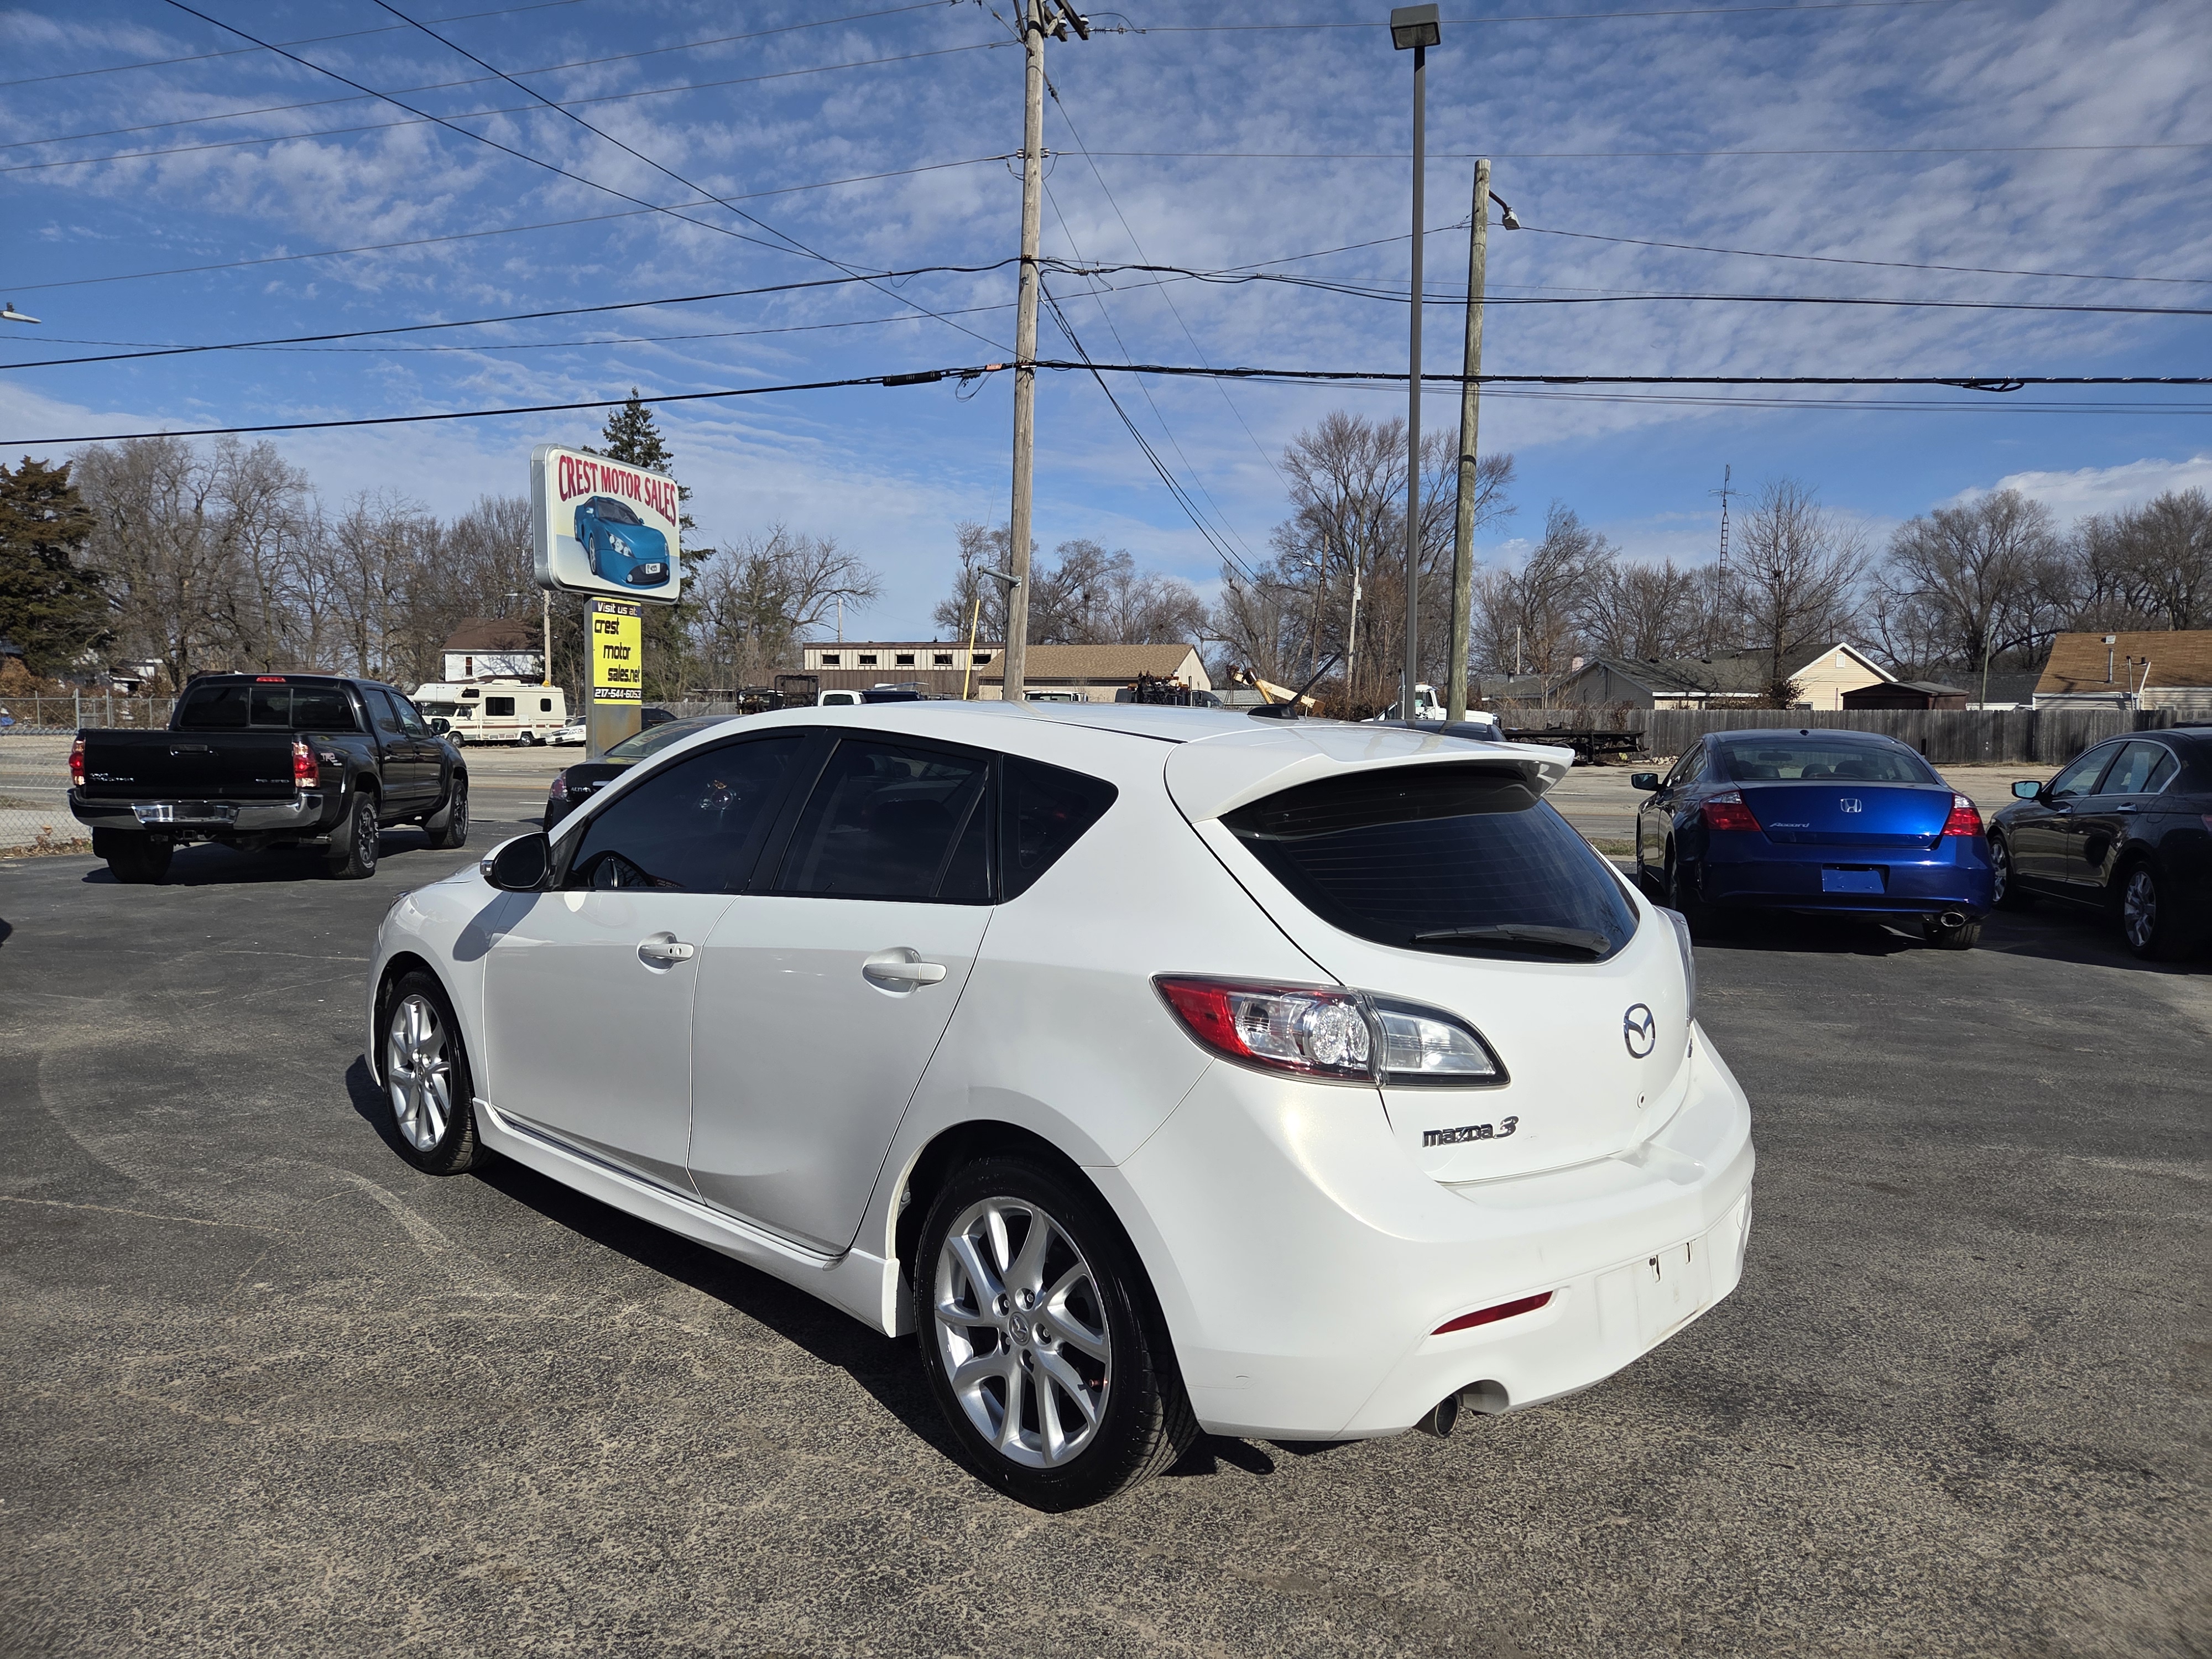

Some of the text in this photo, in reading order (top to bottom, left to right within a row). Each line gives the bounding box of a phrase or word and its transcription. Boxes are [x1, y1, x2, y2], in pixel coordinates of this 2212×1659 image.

[559, 455, 676, 527] CREST MOTOR SALES
[598, 602, 615, 613] Visit
[618, 606, 628, 614] us
[594, 617, 619, 635] crest
[603, 641, 631, 660] motor
[608, 664, 640, 683] sales.net
[594, 688, 641, 698] 217-544-6053
